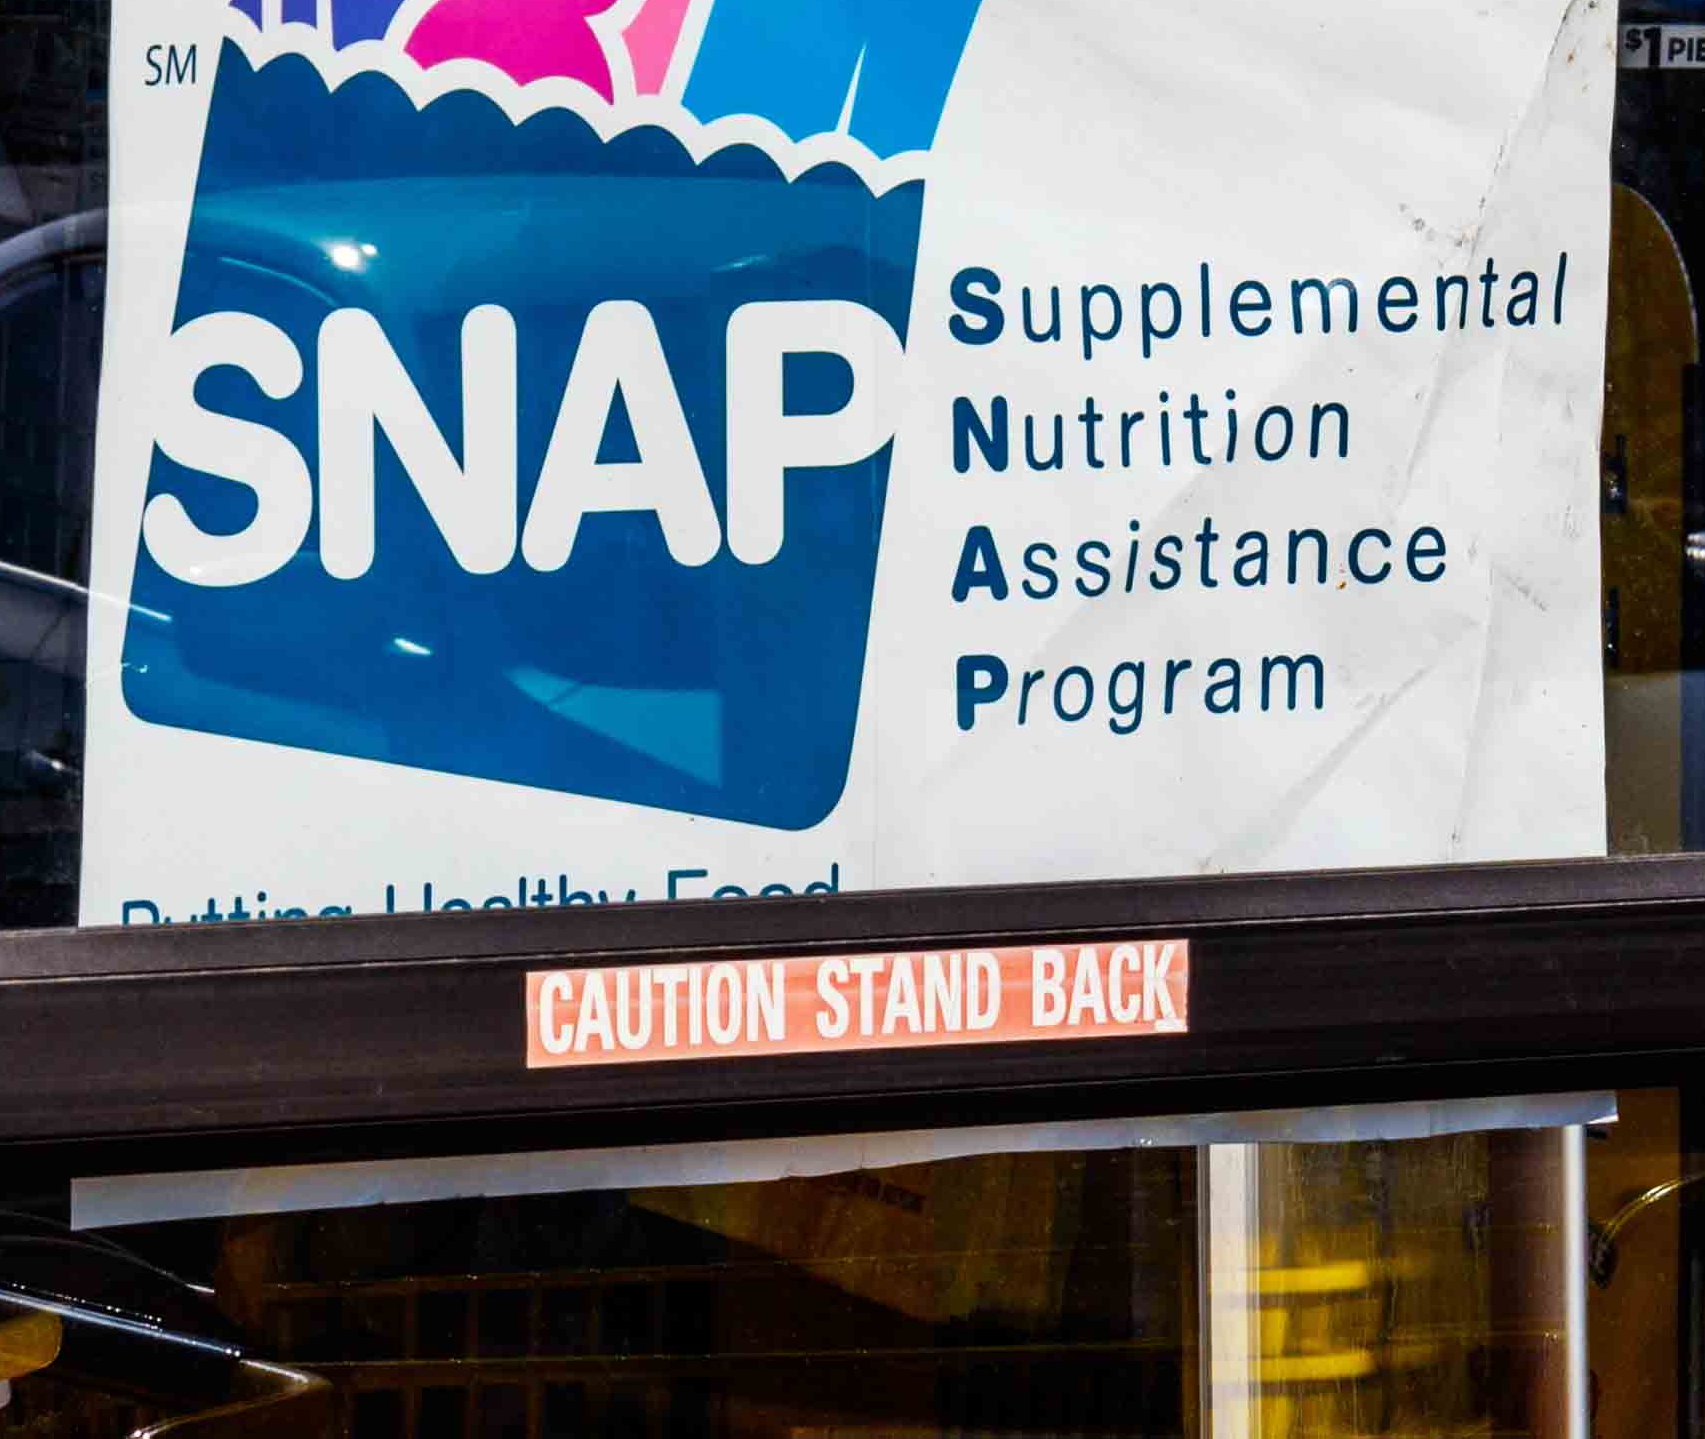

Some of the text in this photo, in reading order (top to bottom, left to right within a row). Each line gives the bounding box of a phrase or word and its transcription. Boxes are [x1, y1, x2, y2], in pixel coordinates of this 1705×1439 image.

[144, 44, 197, 87] SM
[1625, 28, 1661, 67] $1
[947, 251, 1568, 361] Supplemental
[143, 299, 906, 588] SNAP
[951, 388, 1349, 474] Nutrition
[951, 517, 1447, 603] Assistance
[956, 654, 1325, 736] Program
[538, 943, 1181, 1053] CAUTION STAND BACK
